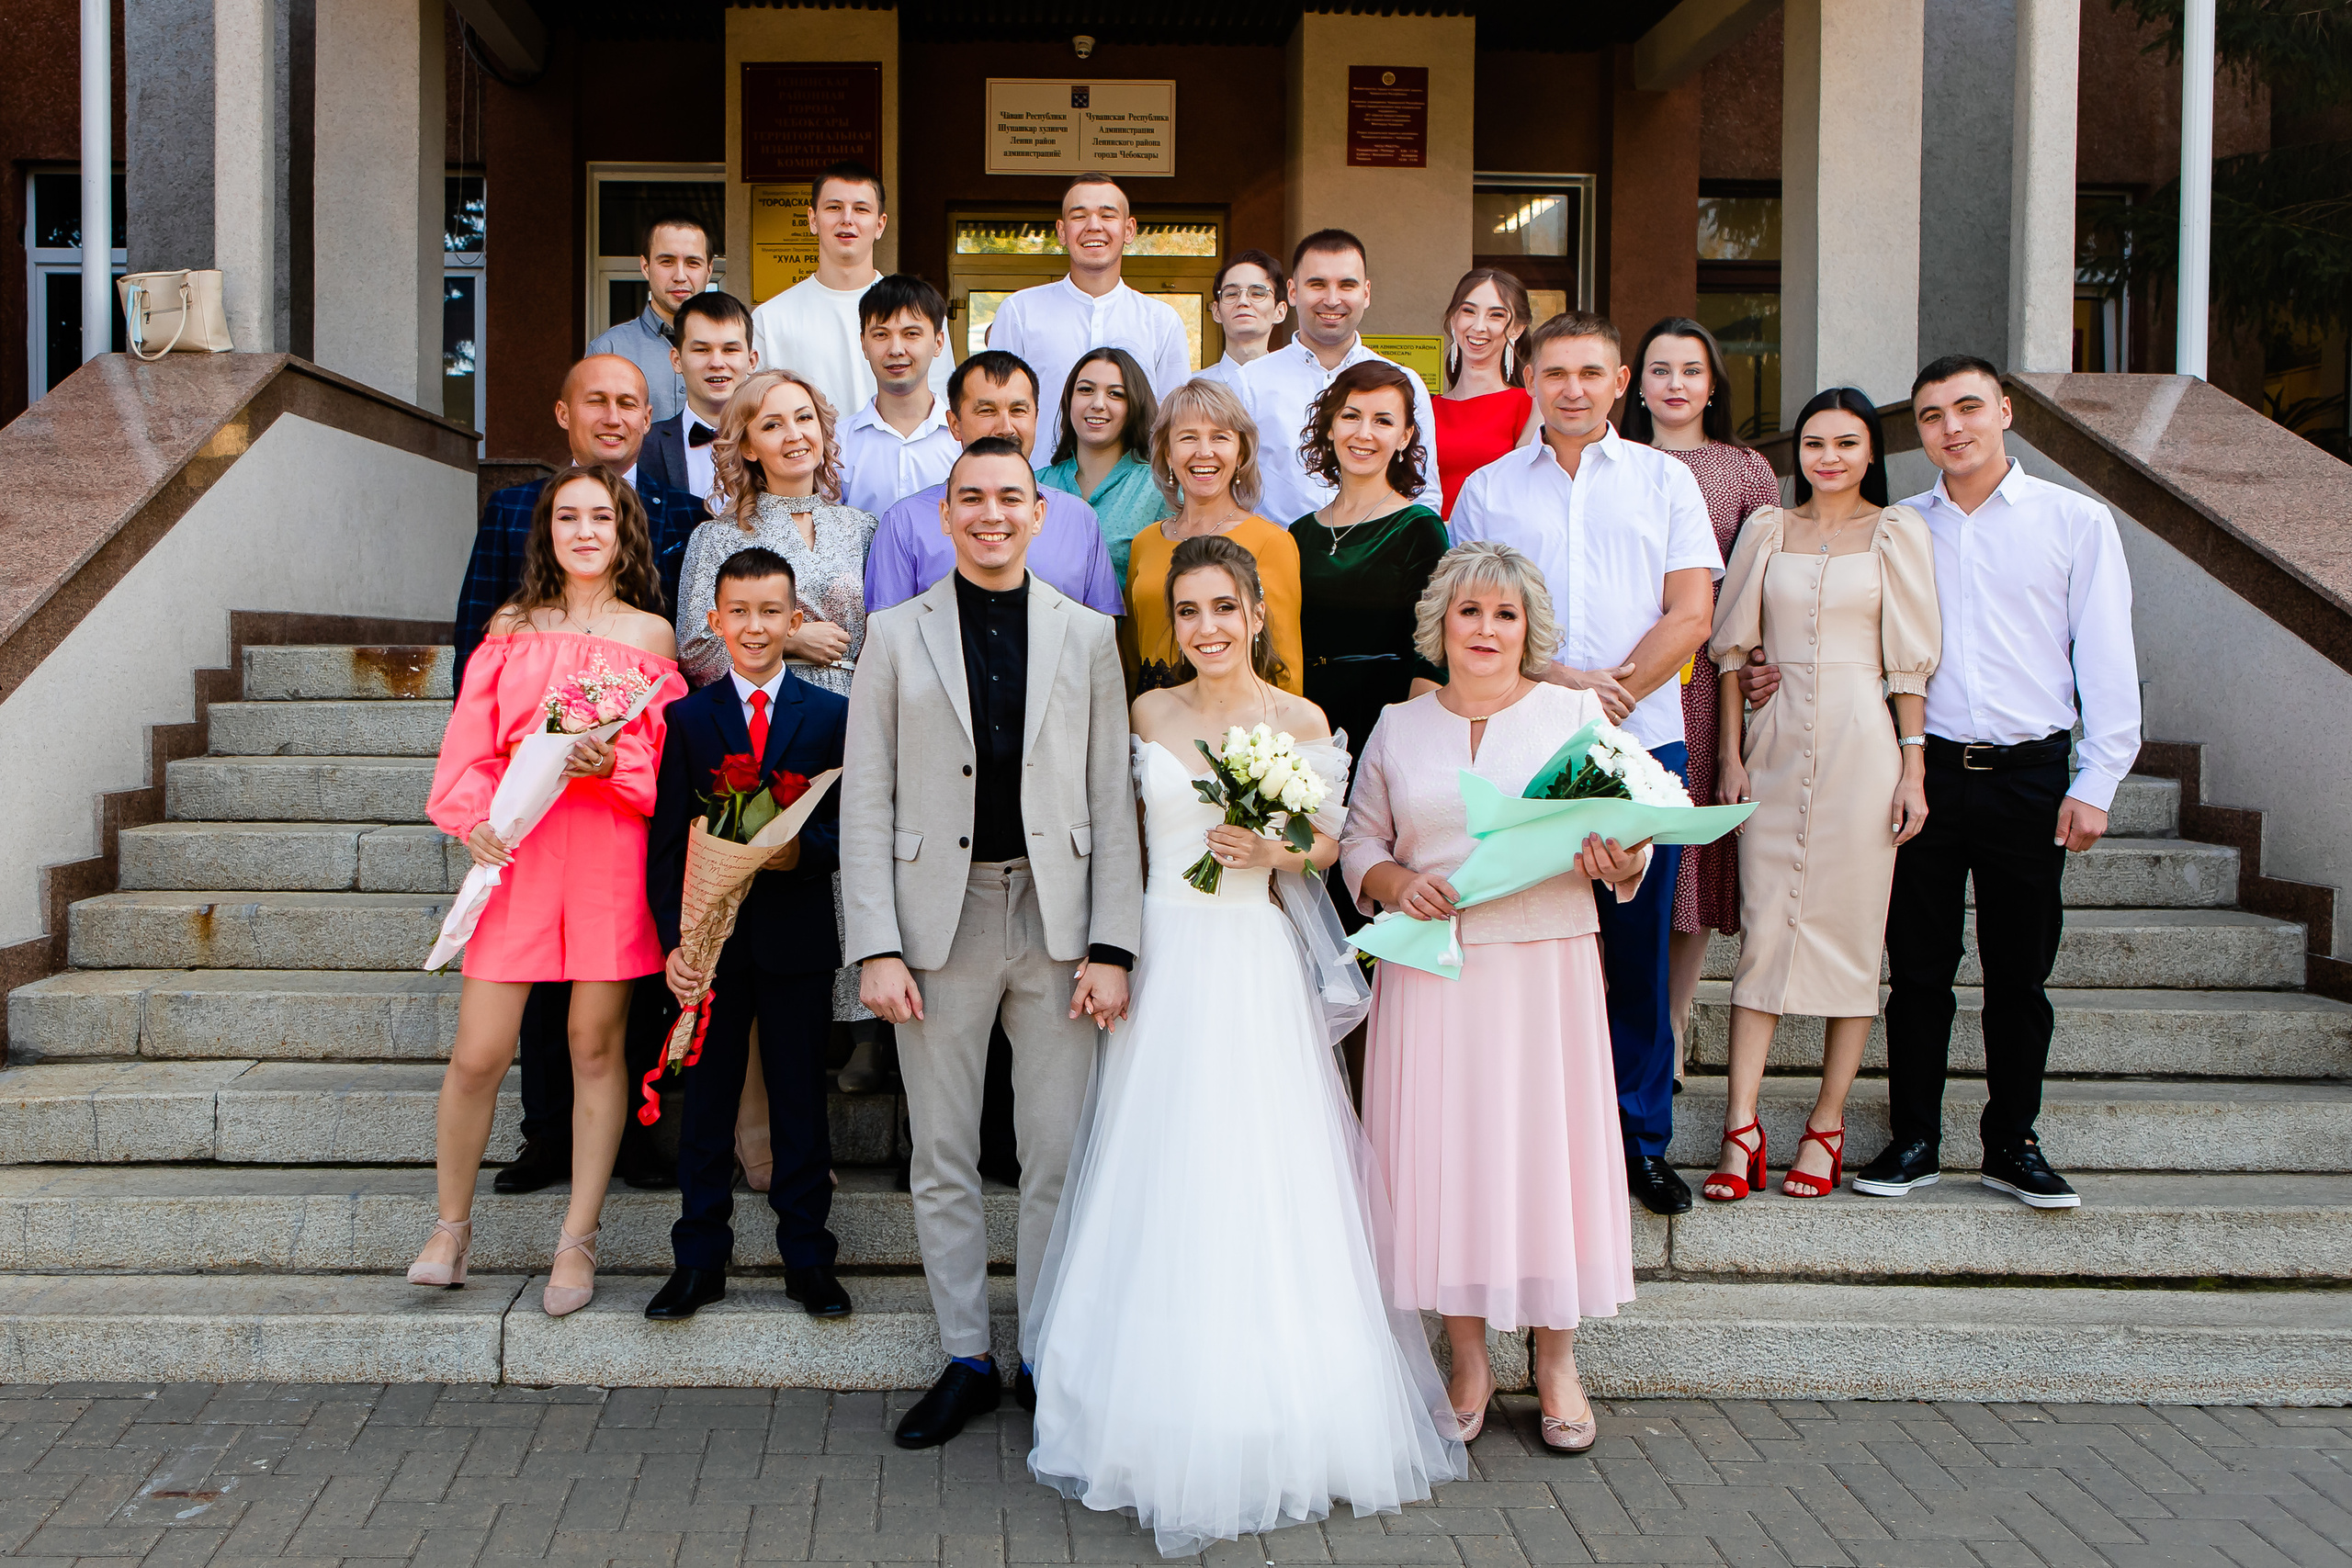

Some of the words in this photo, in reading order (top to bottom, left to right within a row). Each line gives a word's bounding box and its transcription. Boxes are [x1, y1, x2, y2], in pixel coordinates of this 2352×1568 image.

[787, 104, 836, 115] ГОРОДА
[1025, 111, 1068, 122] Республики
[1086, 112, 1125, 122] Чувашская
[1128, 112, 1170, 123] Республика
[774, 118, 850, 128] ЧЕБОКСАРЫ
[998, 124, 1037, 134] Шупашкар
[1099, 126, 1155, 135] Администрация
[752, 131, 872, 141] ТЕРРИТОРИАЛЬНАЯ
[1010, 136, 1034, 145] Ленин
[1035, 138, 1057, 146] район
[1092, 137, 1135, 146] Ленинского
[1136, 139, 1161, 148] района
[761, 144, 864, 154] ИЗБИРАТЕЛЬНАЯ
[1094, 152, 1118, 160] города
[1119, 150, 1159, 161] Чебоксары
[776, 157, 849, 168] КОМИССИ
